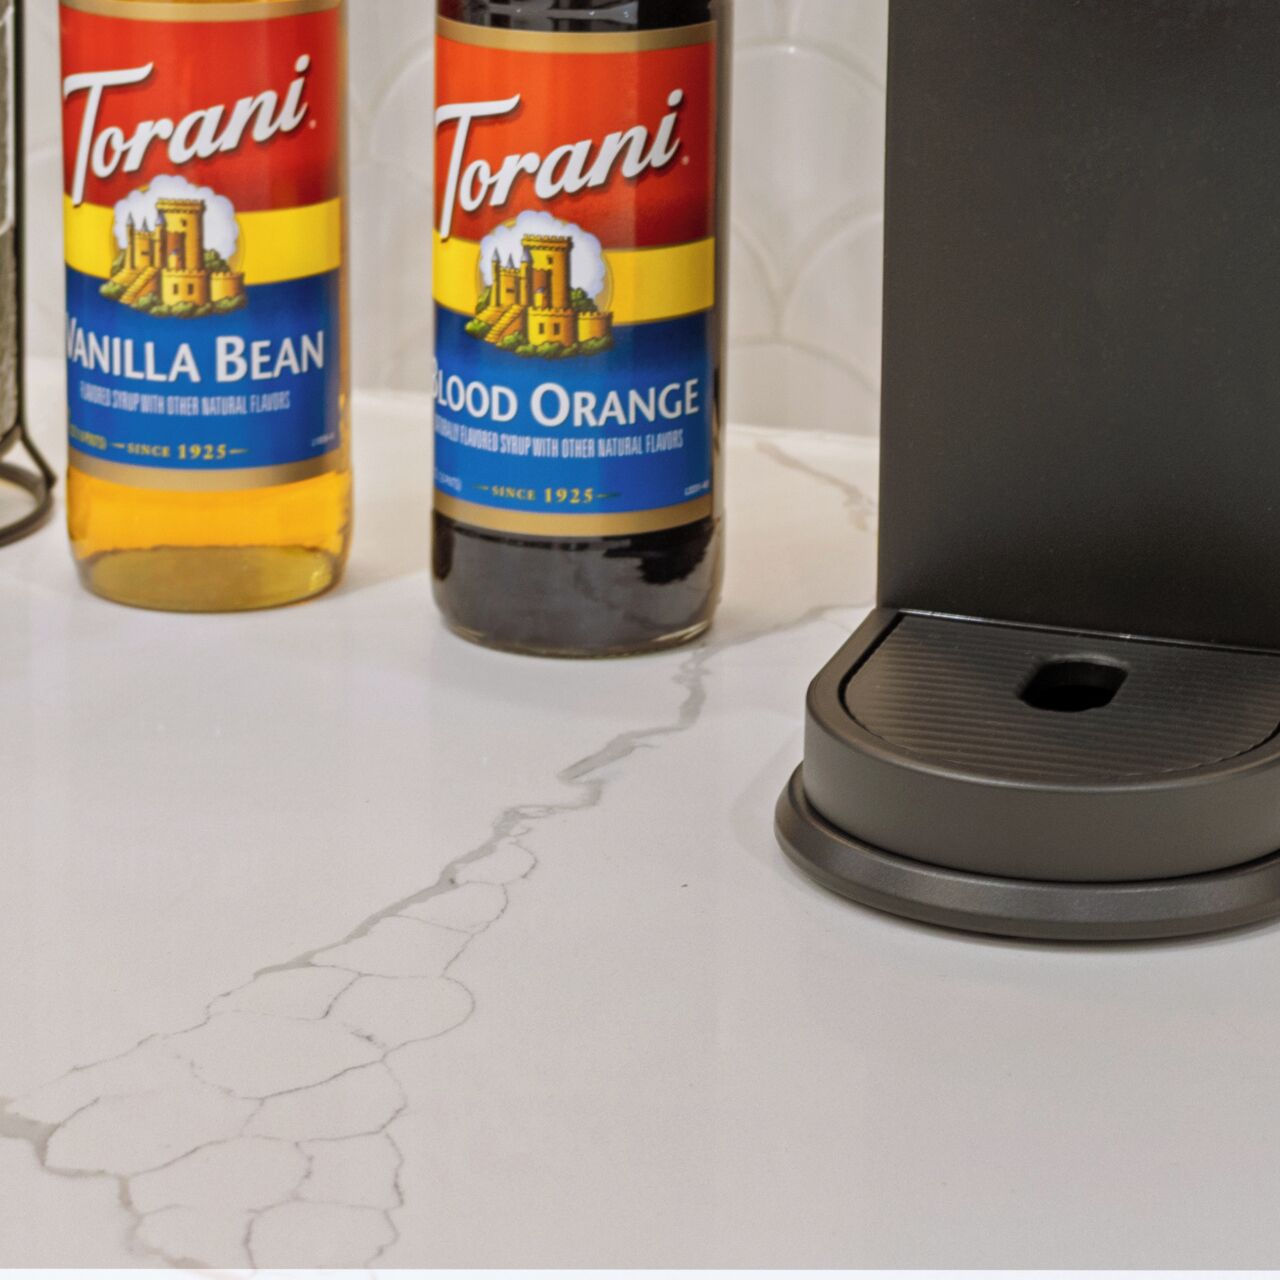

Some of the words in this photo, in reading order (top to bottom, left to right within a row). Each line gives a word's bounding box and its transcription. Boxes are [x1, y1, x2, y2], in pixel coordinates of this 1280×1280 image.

[64, 54, 310, 207] Torani
[436, 88, 683, 240] Torani
[216, 331, 324, 383] BEAN
[167, 395, 199, 416] OTHER
[201, 394, 247, 416] NATURAL
[250, 390, 290, 414] FLAVORS
[531, 379, 700, 427] ORANGE
[127, 441, 171, 458] SINCE
[178, 443, 227, 460] 1925
[500, 431, 531, 456] SYRUP
[532, 436, 558, 457] WITH
[561, 438, 595, 458] OTHER
[598, 436, 642, 458] NATURAL
[645, 429, 684, 454] FLAVORS
[492, 485, 536, 501] SINCE
[543, 488, 594, 504] 1925
